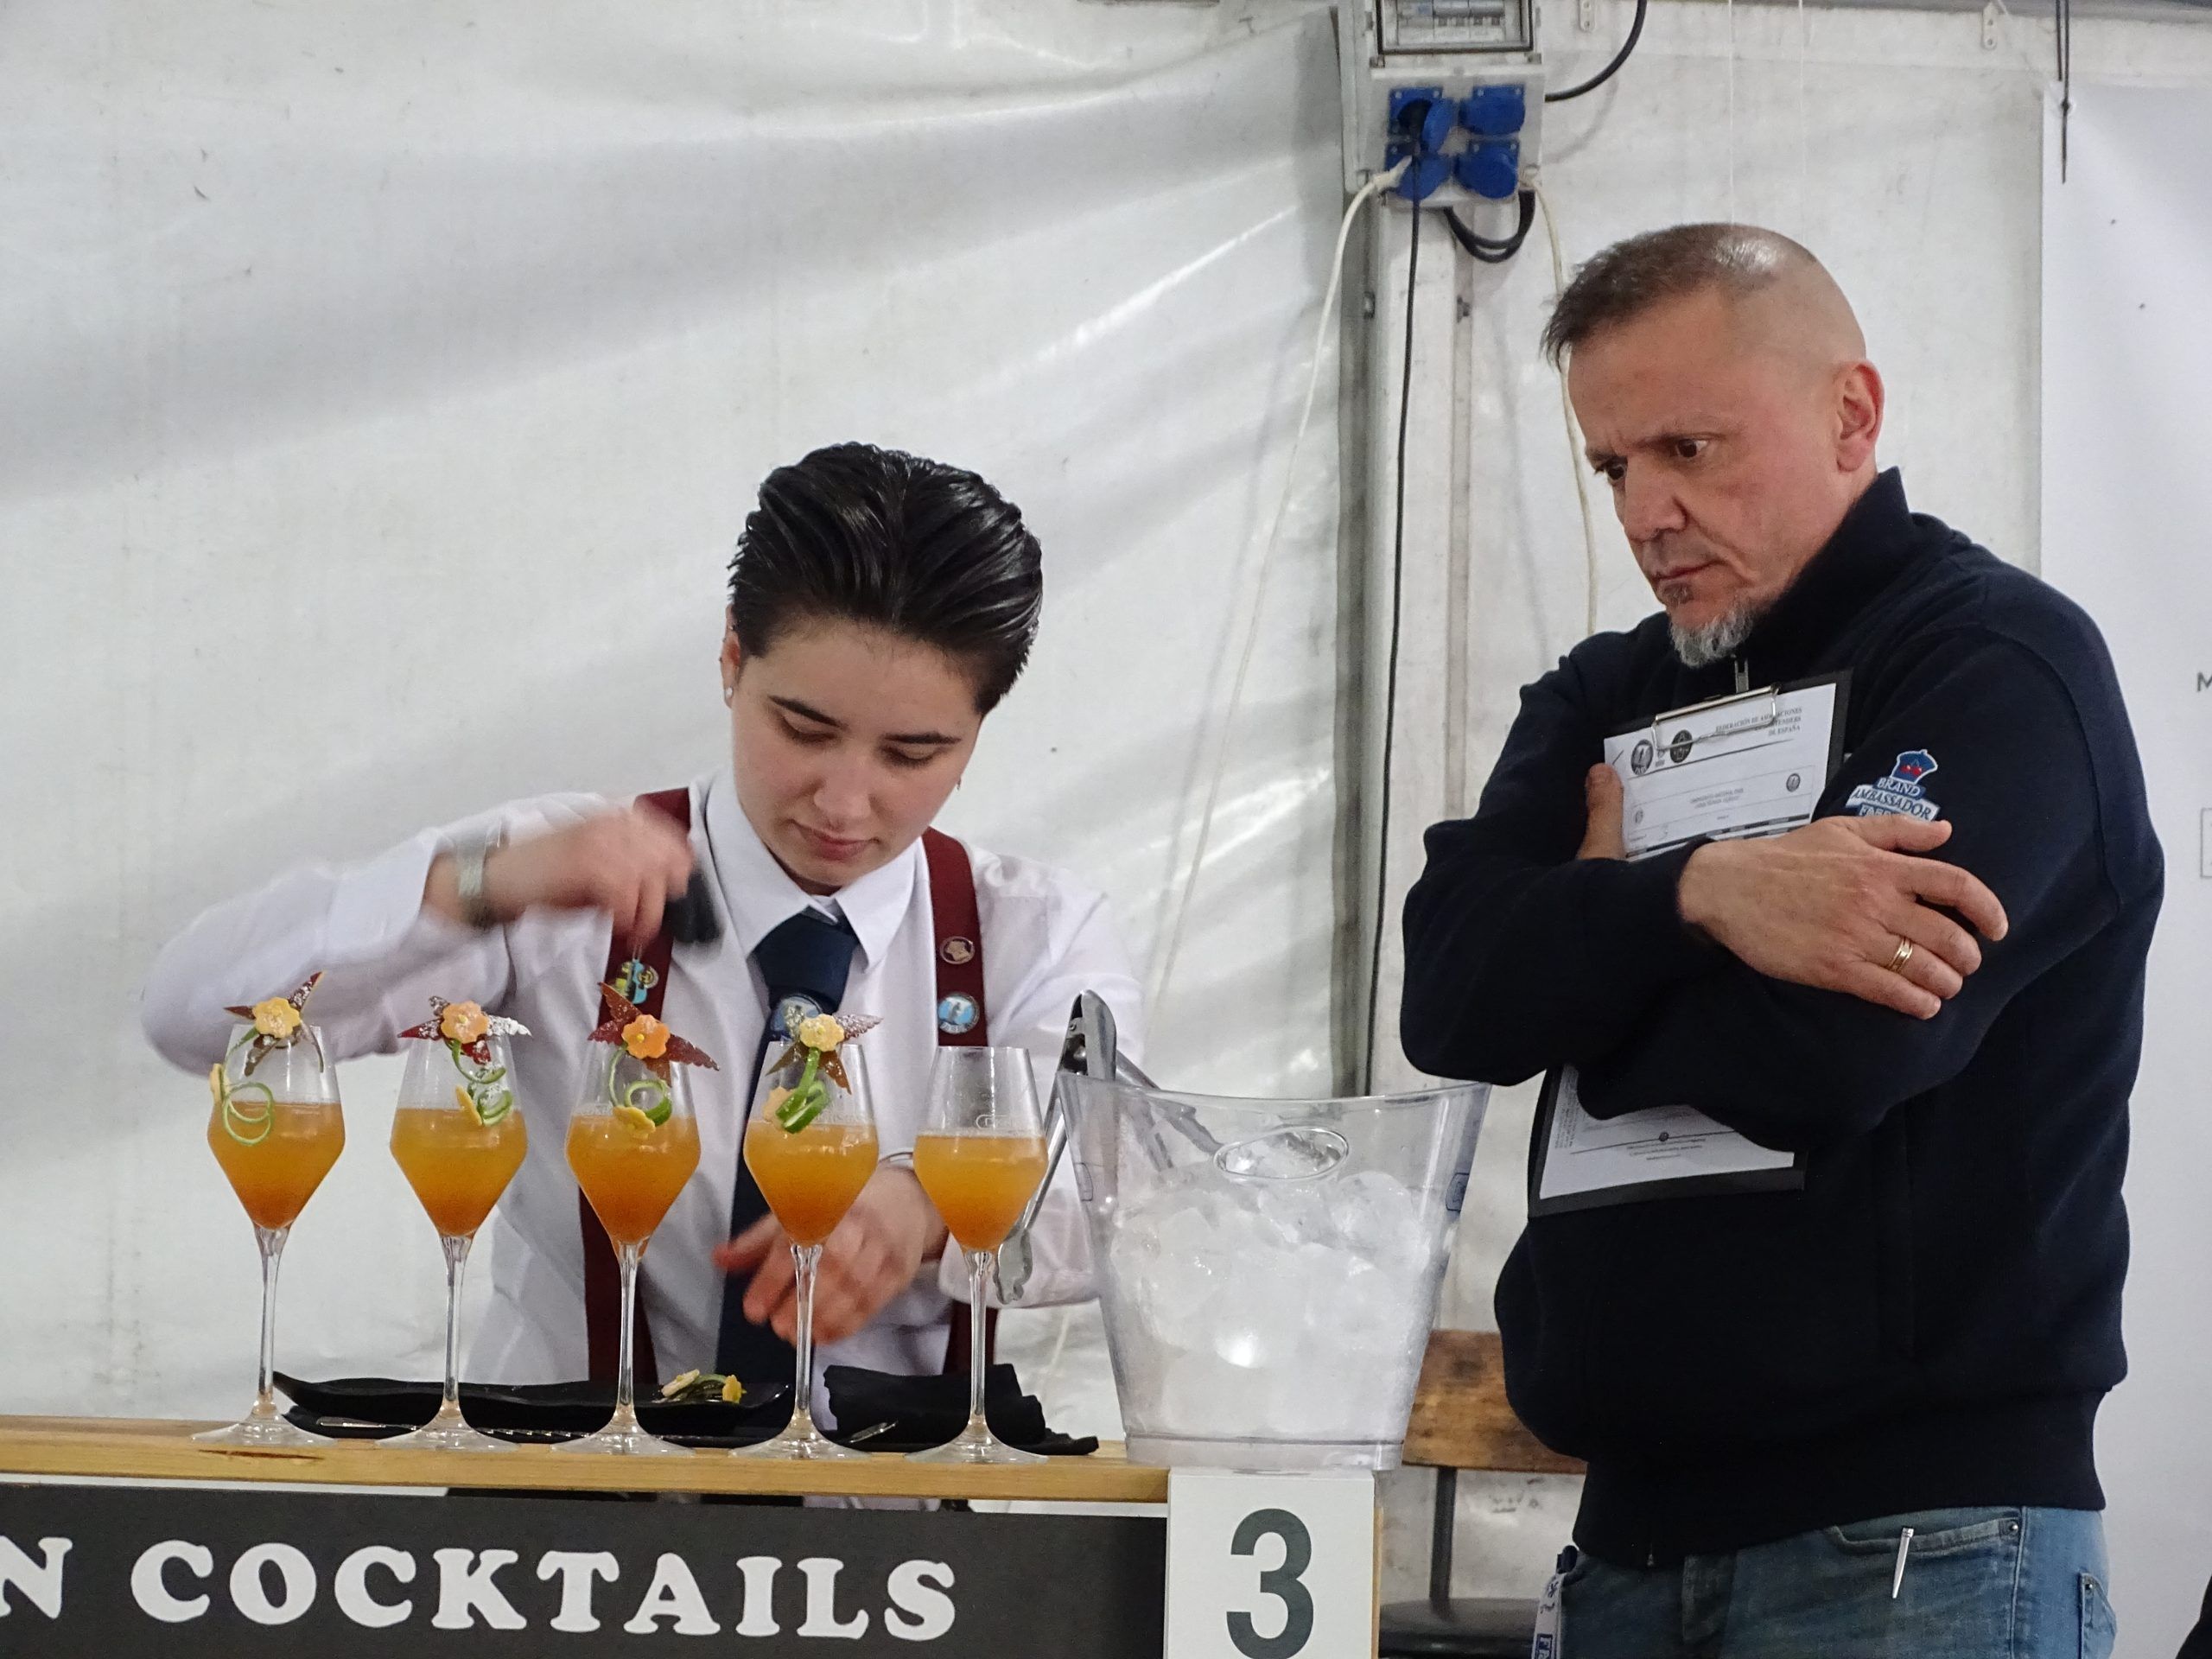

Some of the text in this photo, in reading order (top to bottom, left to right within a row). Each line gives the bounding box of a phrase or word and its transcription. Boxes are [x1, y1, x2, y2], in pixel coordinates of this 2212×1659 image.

[1853, 787, 1932, 819] AMBASSADOR
[1877, 778, 1920, 797] BRAND
[0, 1536, 955, 1640] N COCKTAILS
[1227, 1509, 1313, 1659] 3
